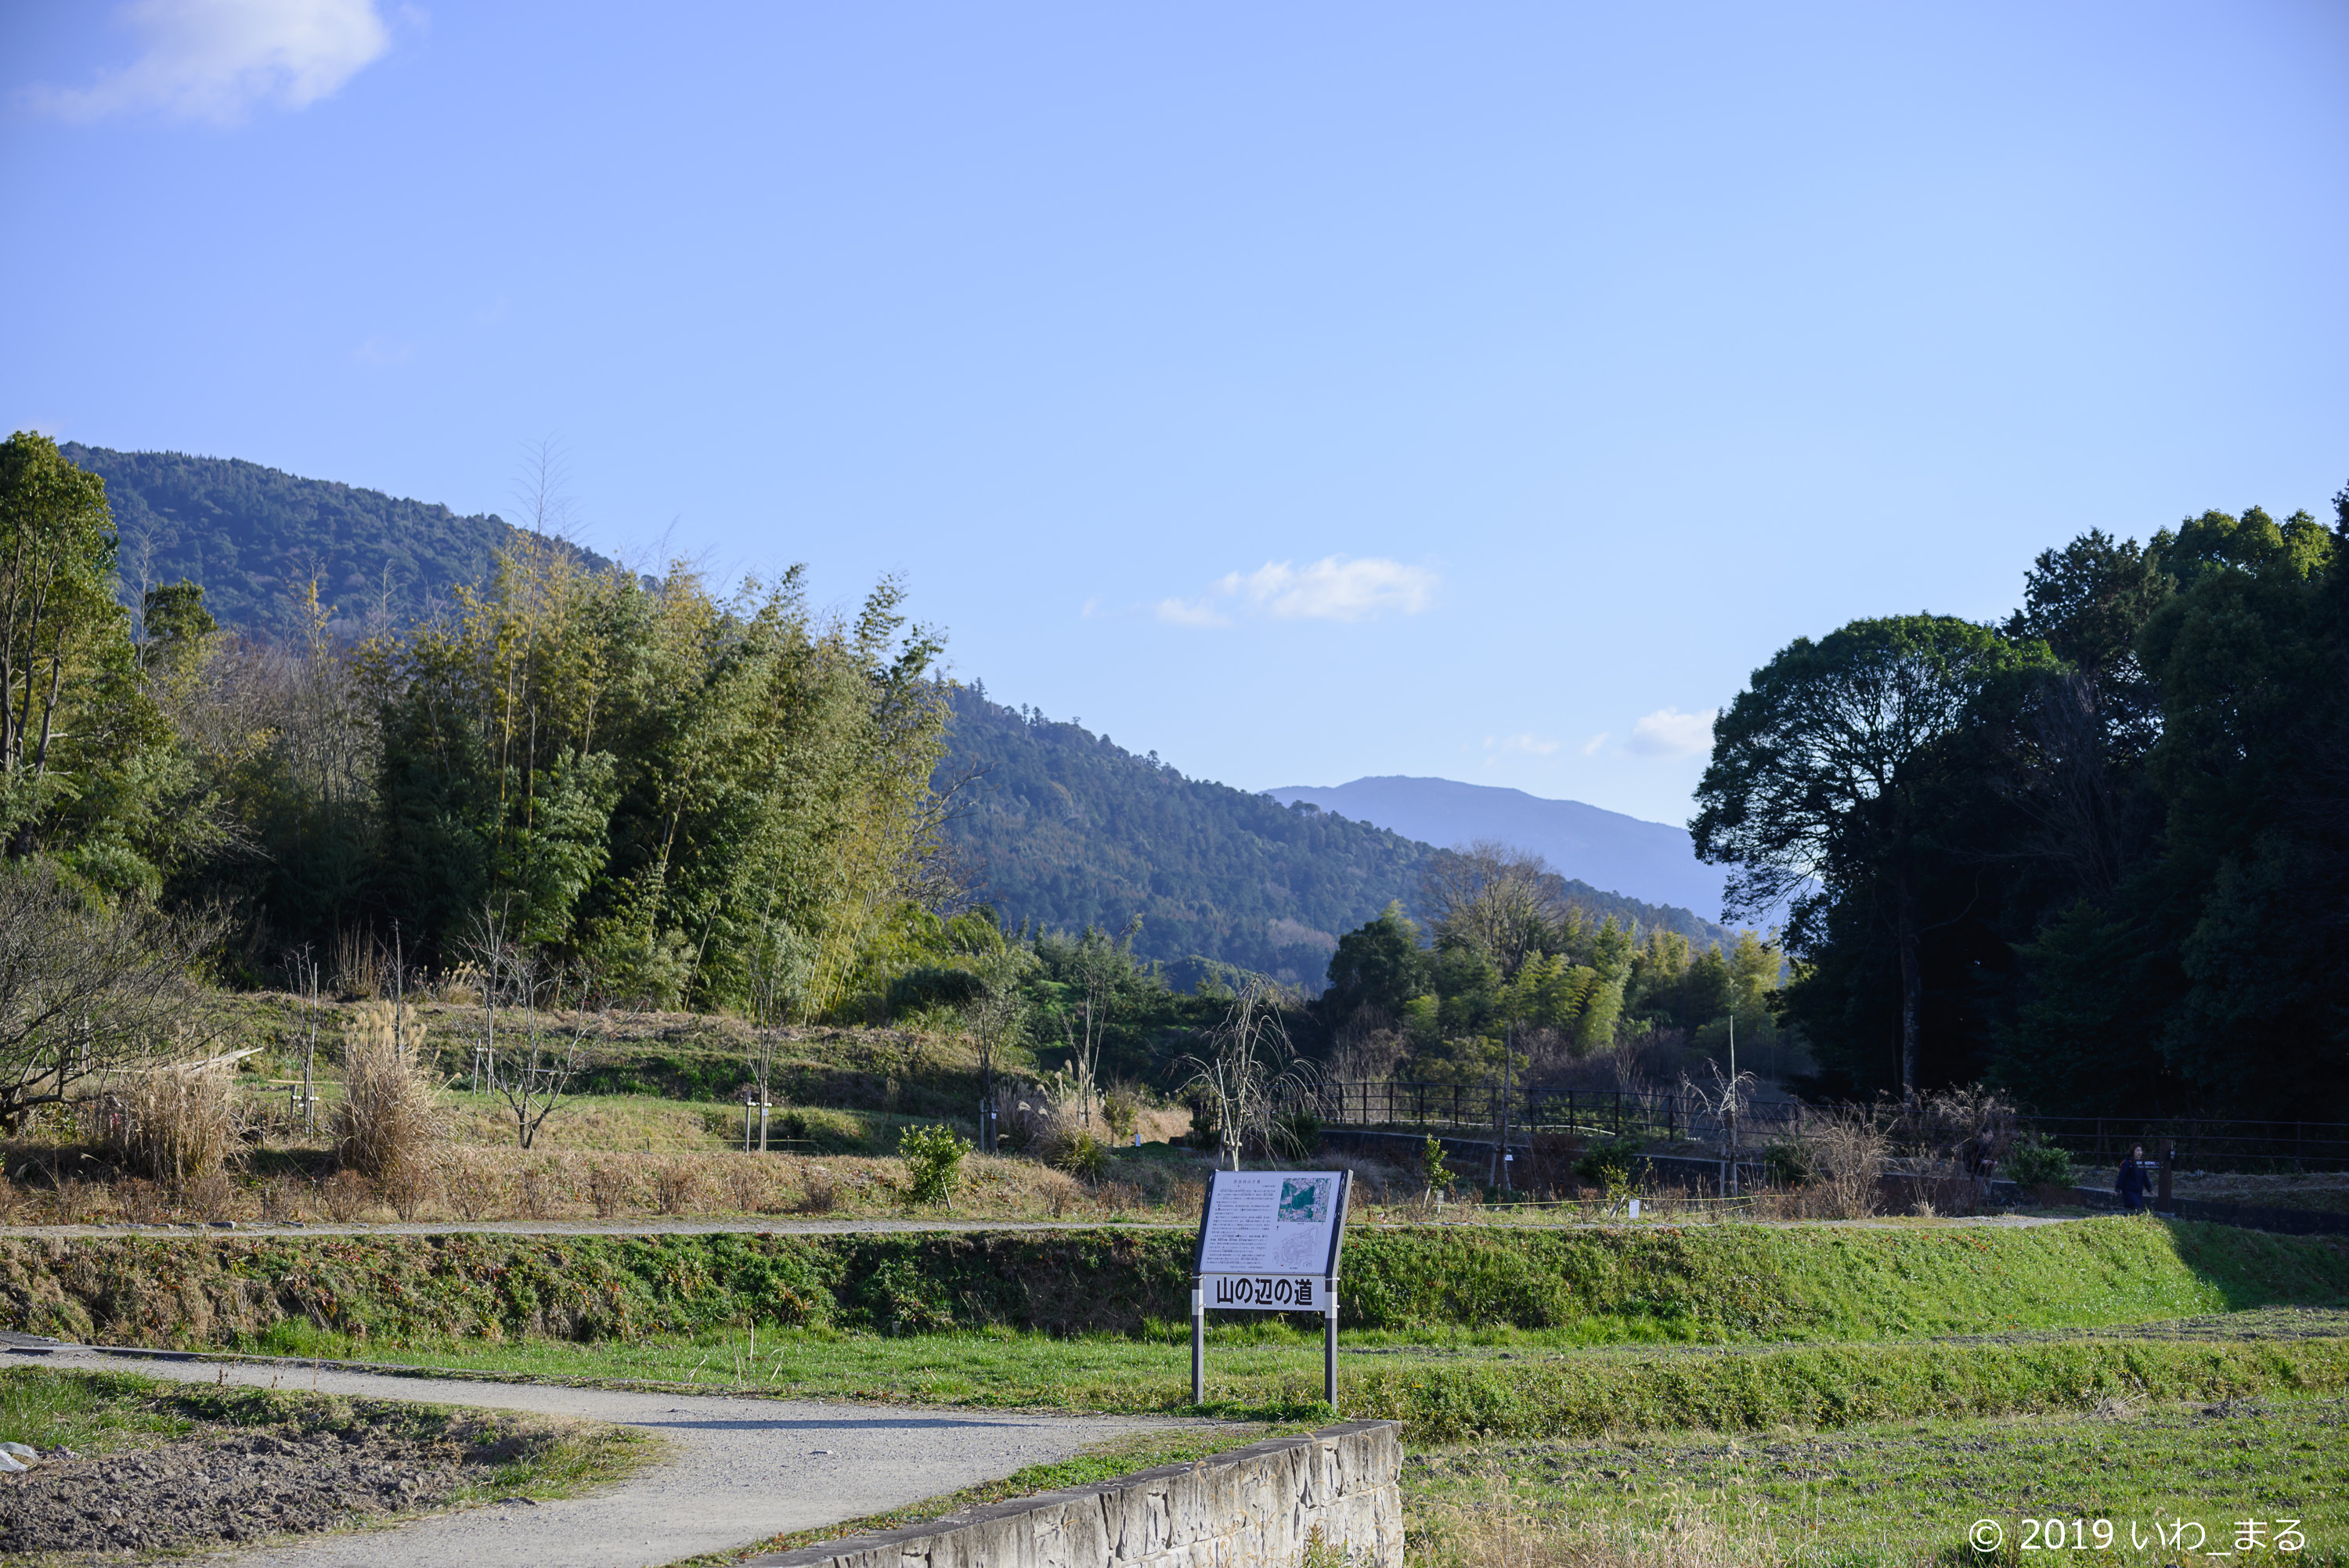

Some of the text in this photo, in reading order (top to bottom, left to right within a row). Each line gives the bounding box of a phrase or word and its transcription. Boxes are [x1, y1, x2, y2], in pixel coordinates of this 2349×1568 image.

[1217, 1277, 1313, 1306] 山の辺の道
